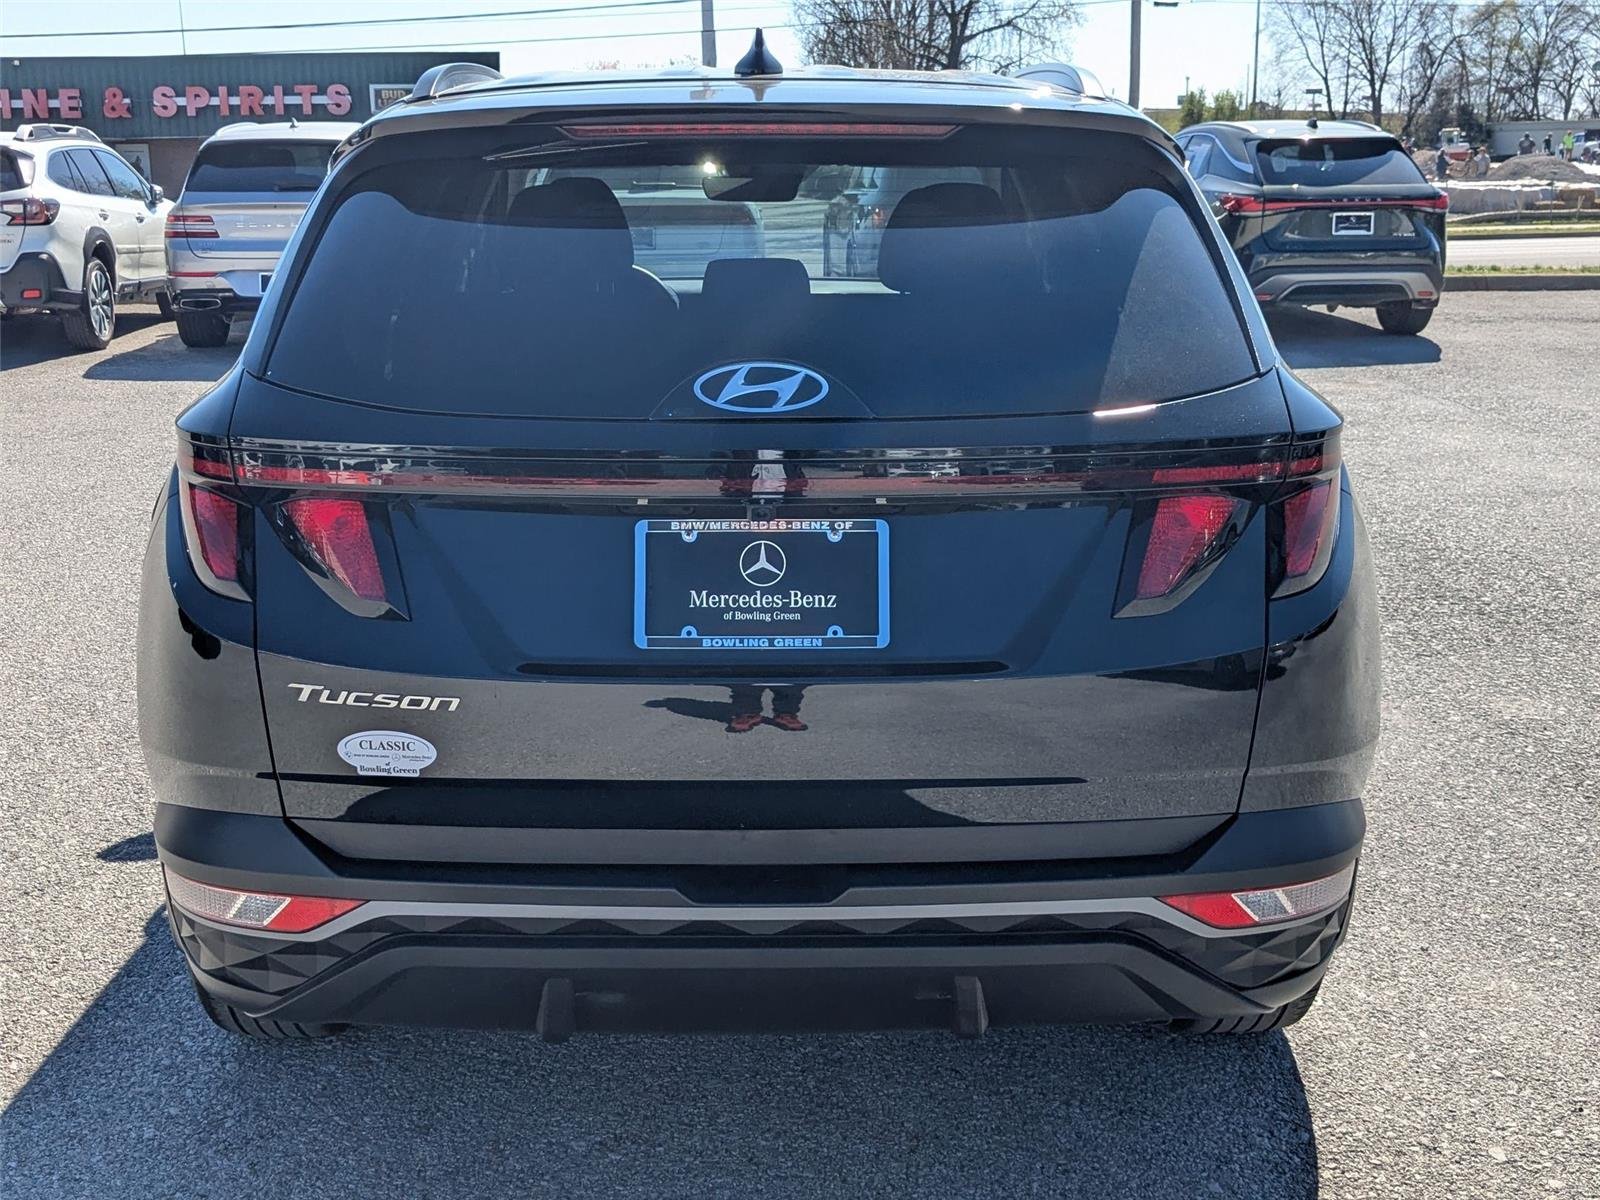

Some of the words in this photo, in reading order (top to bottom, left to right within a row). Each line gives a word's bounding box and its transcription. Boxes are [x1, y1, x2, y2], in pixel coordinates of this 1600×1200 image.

[103, 86, 132, 118] &
[153, 84, 352, 118] SPIRITS
[671, 521, 830, 530] BMW/MERCEDES-BENZ
[834, 521, 853, 530] OF
[689, 590, 837, 608] Mercedes-Benz
[723, 611, 733, 621] of
[735, 610, 771, 622] Bowling
[773, 611, 801, 621] Green
[702, 638, 769, 648] BOWLING
[773, 638, 822, 647] GREEN
[359, 740, 416, 752] CLASSIC
[360, 765, 392, 775] Bowling
[392, 766, 418, 774] Green
